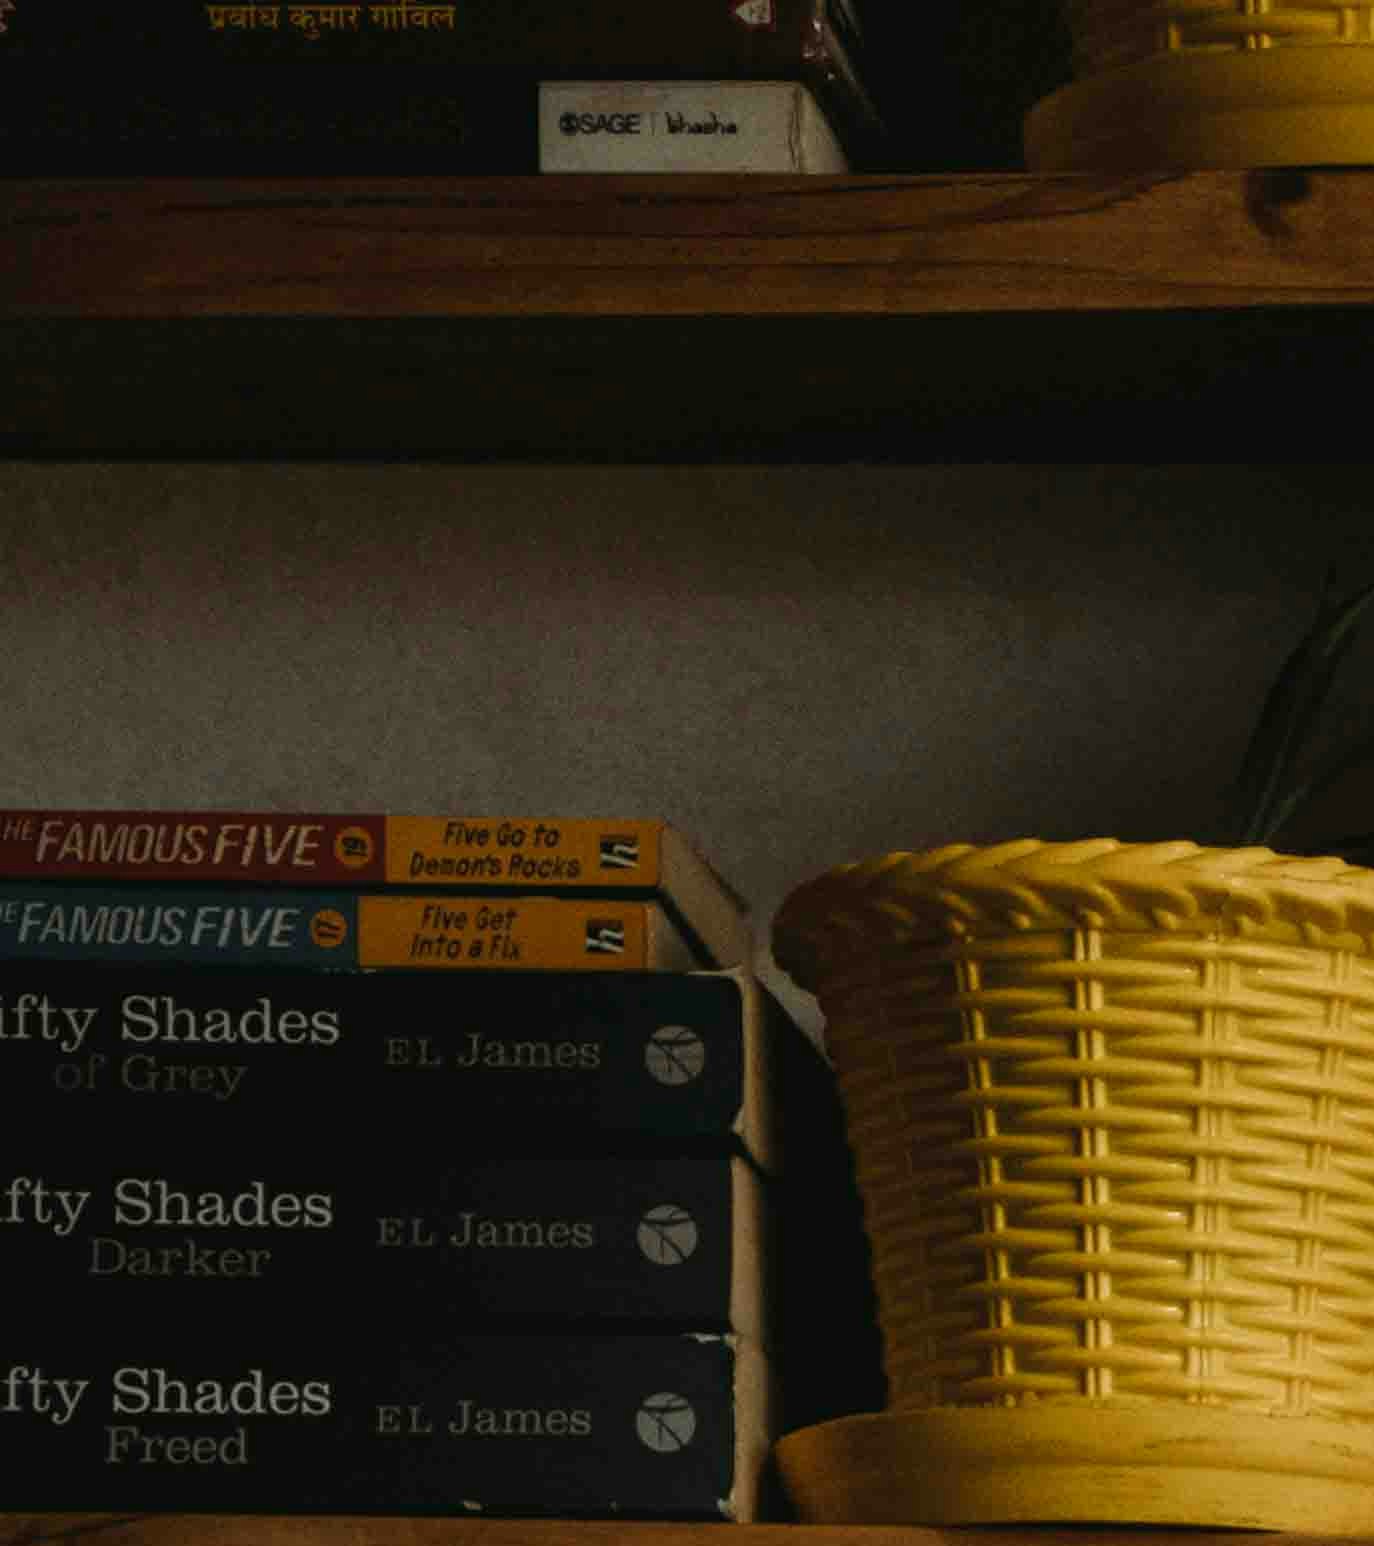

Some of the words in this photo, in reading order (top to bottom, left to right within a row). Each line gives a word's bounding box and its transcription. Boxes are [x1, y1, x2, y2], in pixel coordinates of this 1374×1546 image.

[33, 822, 205, 866] FAMOUS
[212, 822, 322, 866] FIVE
[409, 854, 503, 879] Demon's
[119, 994, 341, 1046] Shades
[55, 1052, 106, 1090] of
[120, 1054, 248, 1100] Grey
[105, 1426, 250, 1465] Freed
